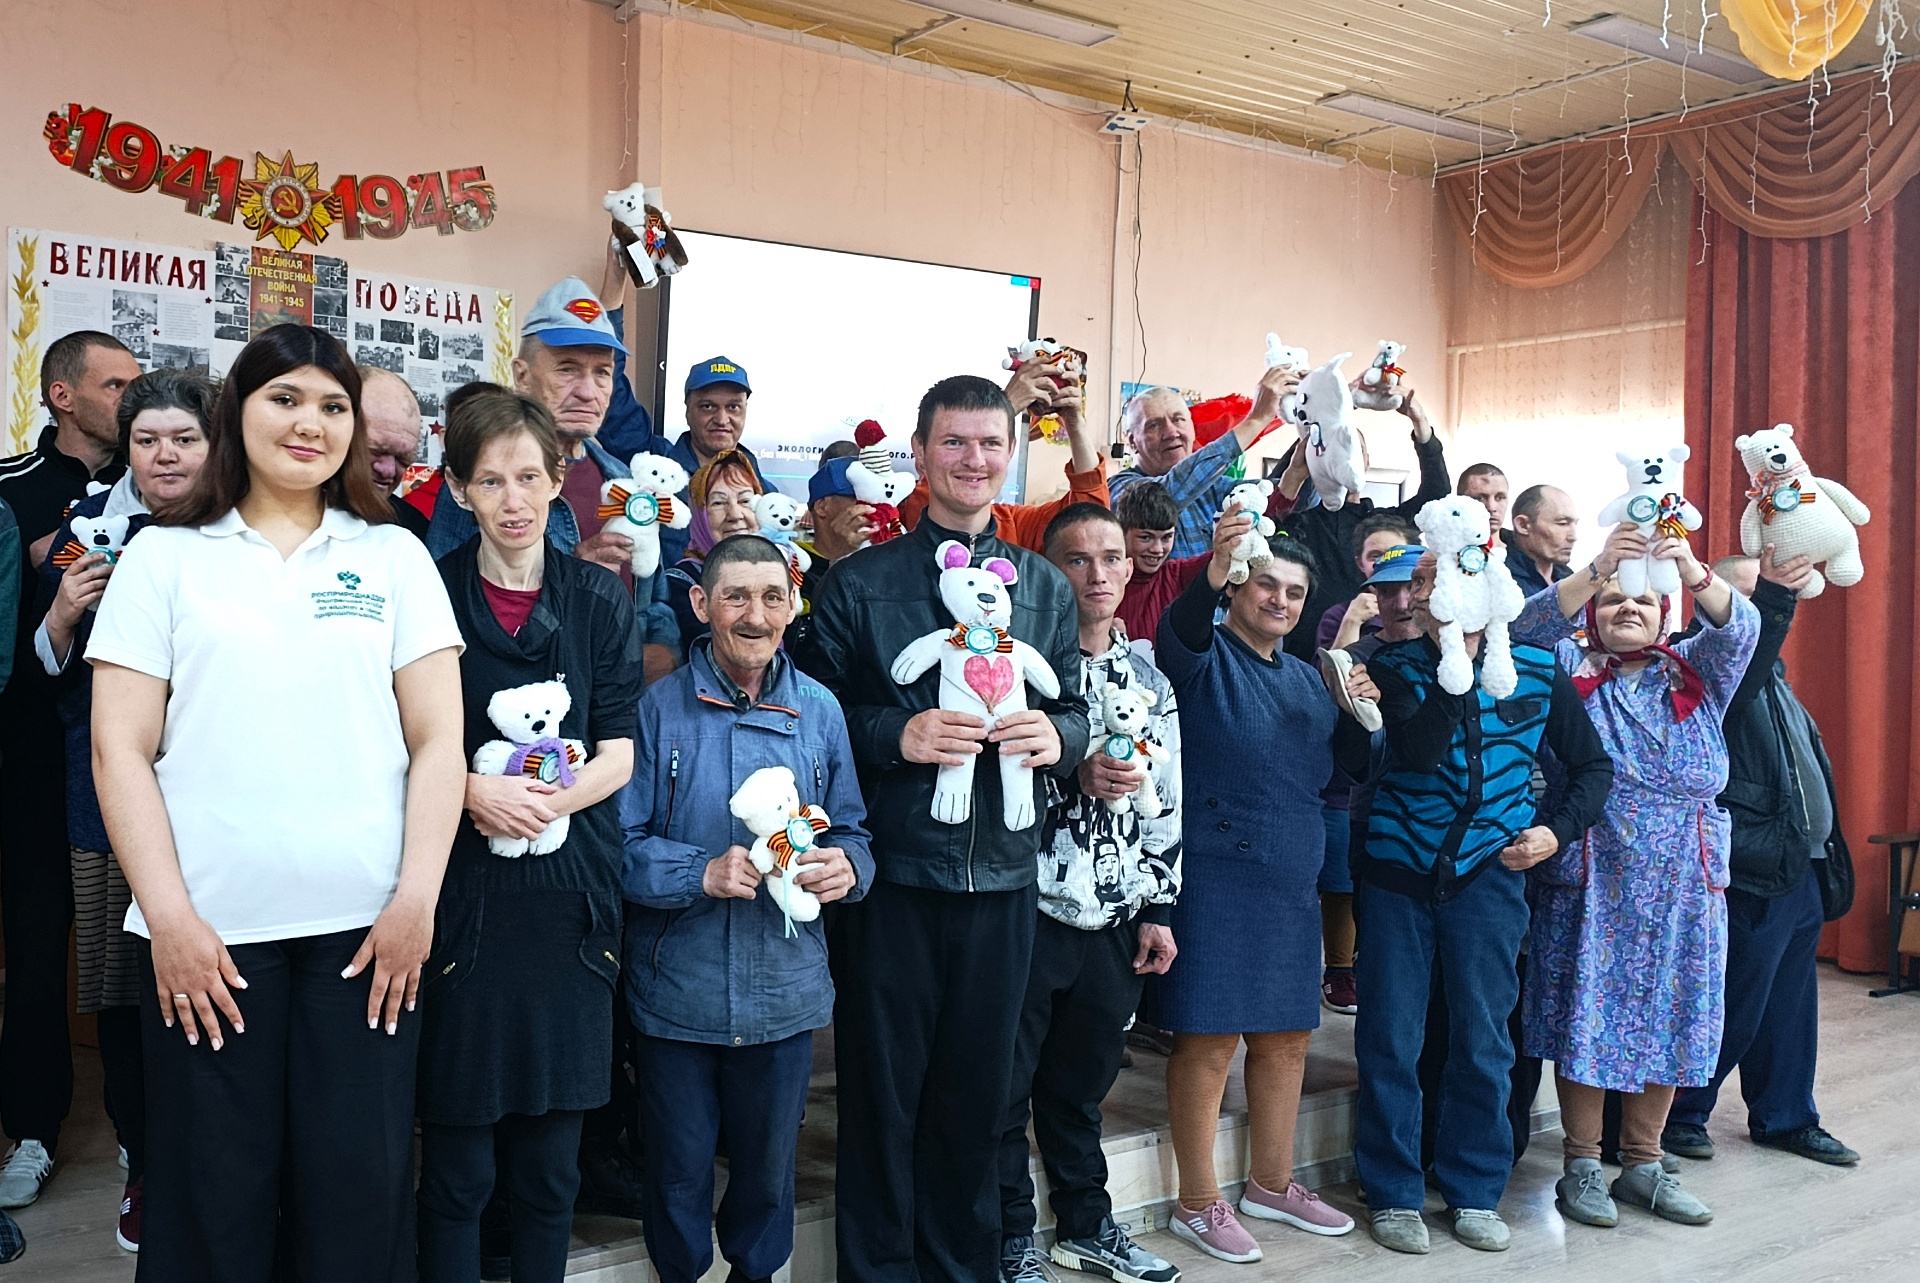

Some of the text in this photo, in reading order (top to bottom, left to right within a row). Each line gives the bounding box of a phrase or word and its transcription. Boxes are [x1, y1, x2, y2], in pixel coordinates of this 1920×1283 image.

[69, 106, 243, 225] 1941
[331, 166, 494, 240] 1945
[50, 242, 205, 290] ВЕЛИКАЯ
[247, 266, 317, 284] ОТЕЧЕСТВЕННАЯ
[262, 255, 302, 270] ВЕЛИКАЯ
[267, 281, 296, 293] ВОЙНА
[356, 278, 482, 324] ПОБЕДА
